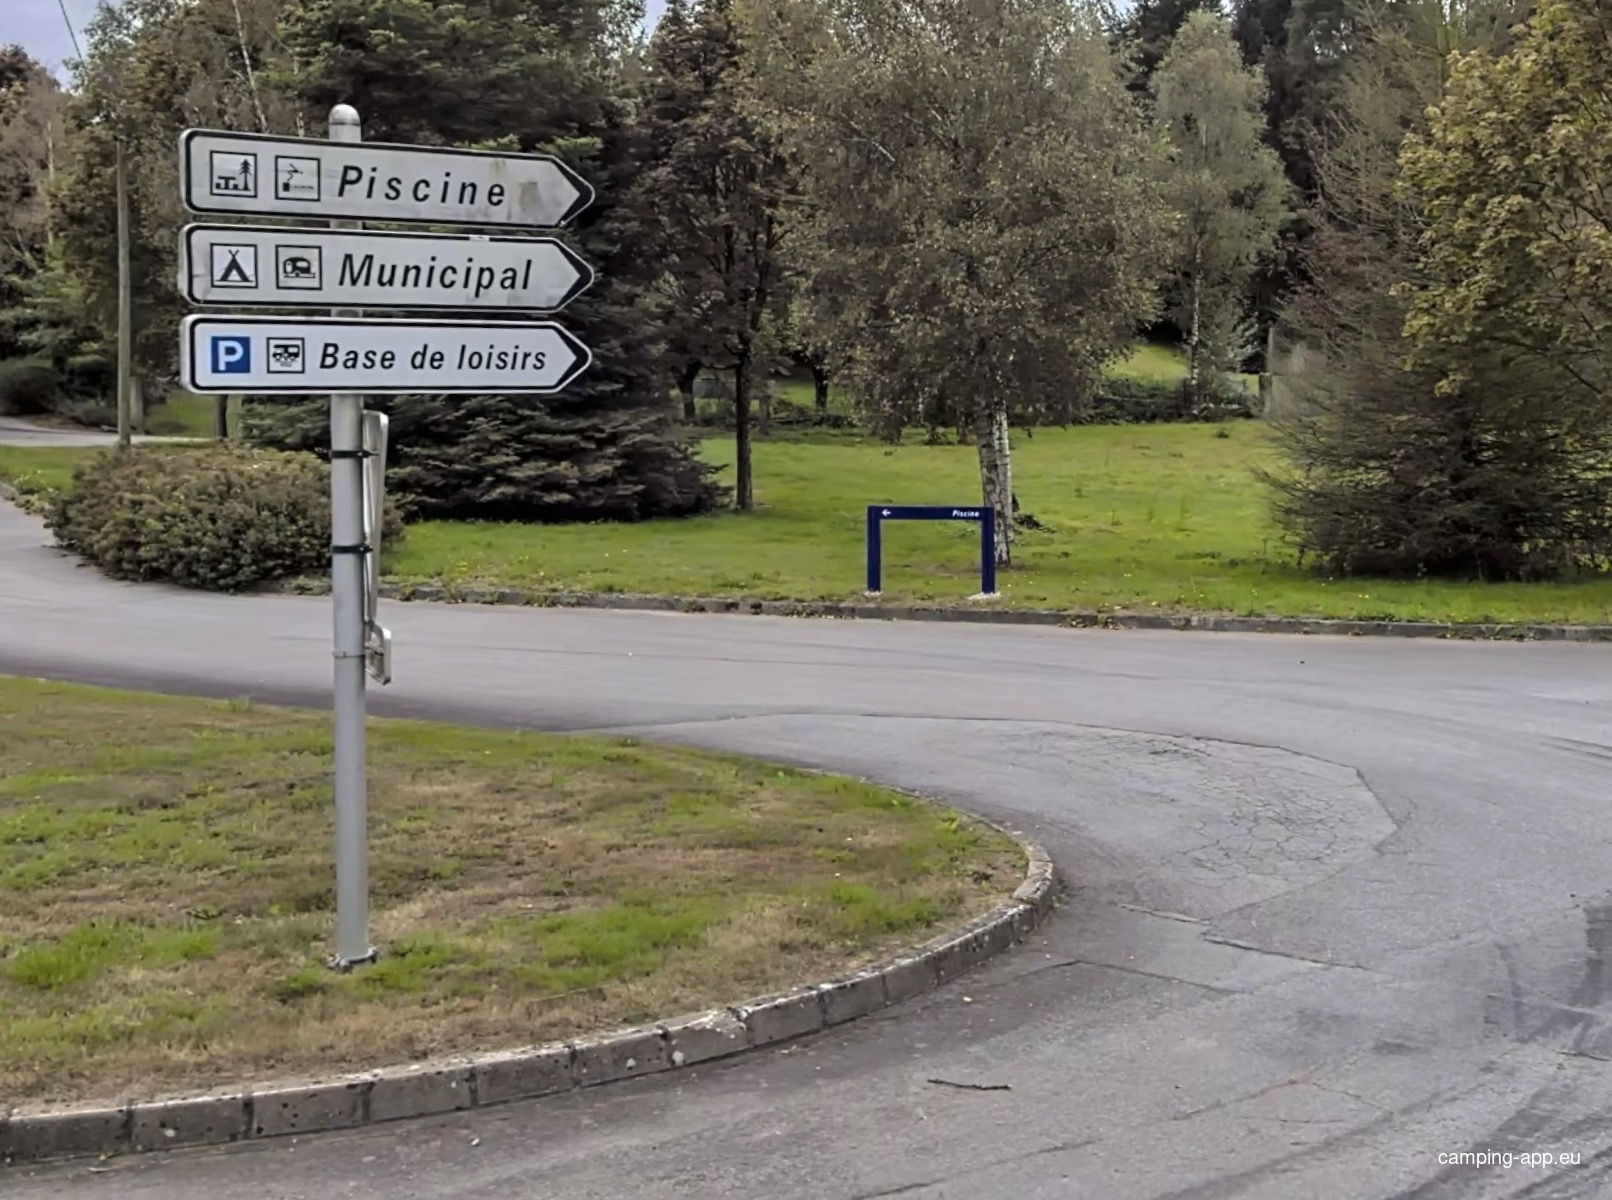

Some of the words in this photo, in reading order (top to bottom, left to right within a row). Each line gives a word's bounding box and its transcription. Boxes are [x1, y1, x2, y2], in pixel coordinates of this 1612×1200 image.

[337, 165, 506, 206] Piscine
[338, 253, 533, 298] Municipal
[217, 340, 244, 371] P
[319, 343, 396, 370] Base
[410, 343, 444, 370] de
[457, 344, 547, 371] loisirs
[952, 509, 979, 517] Piscine
